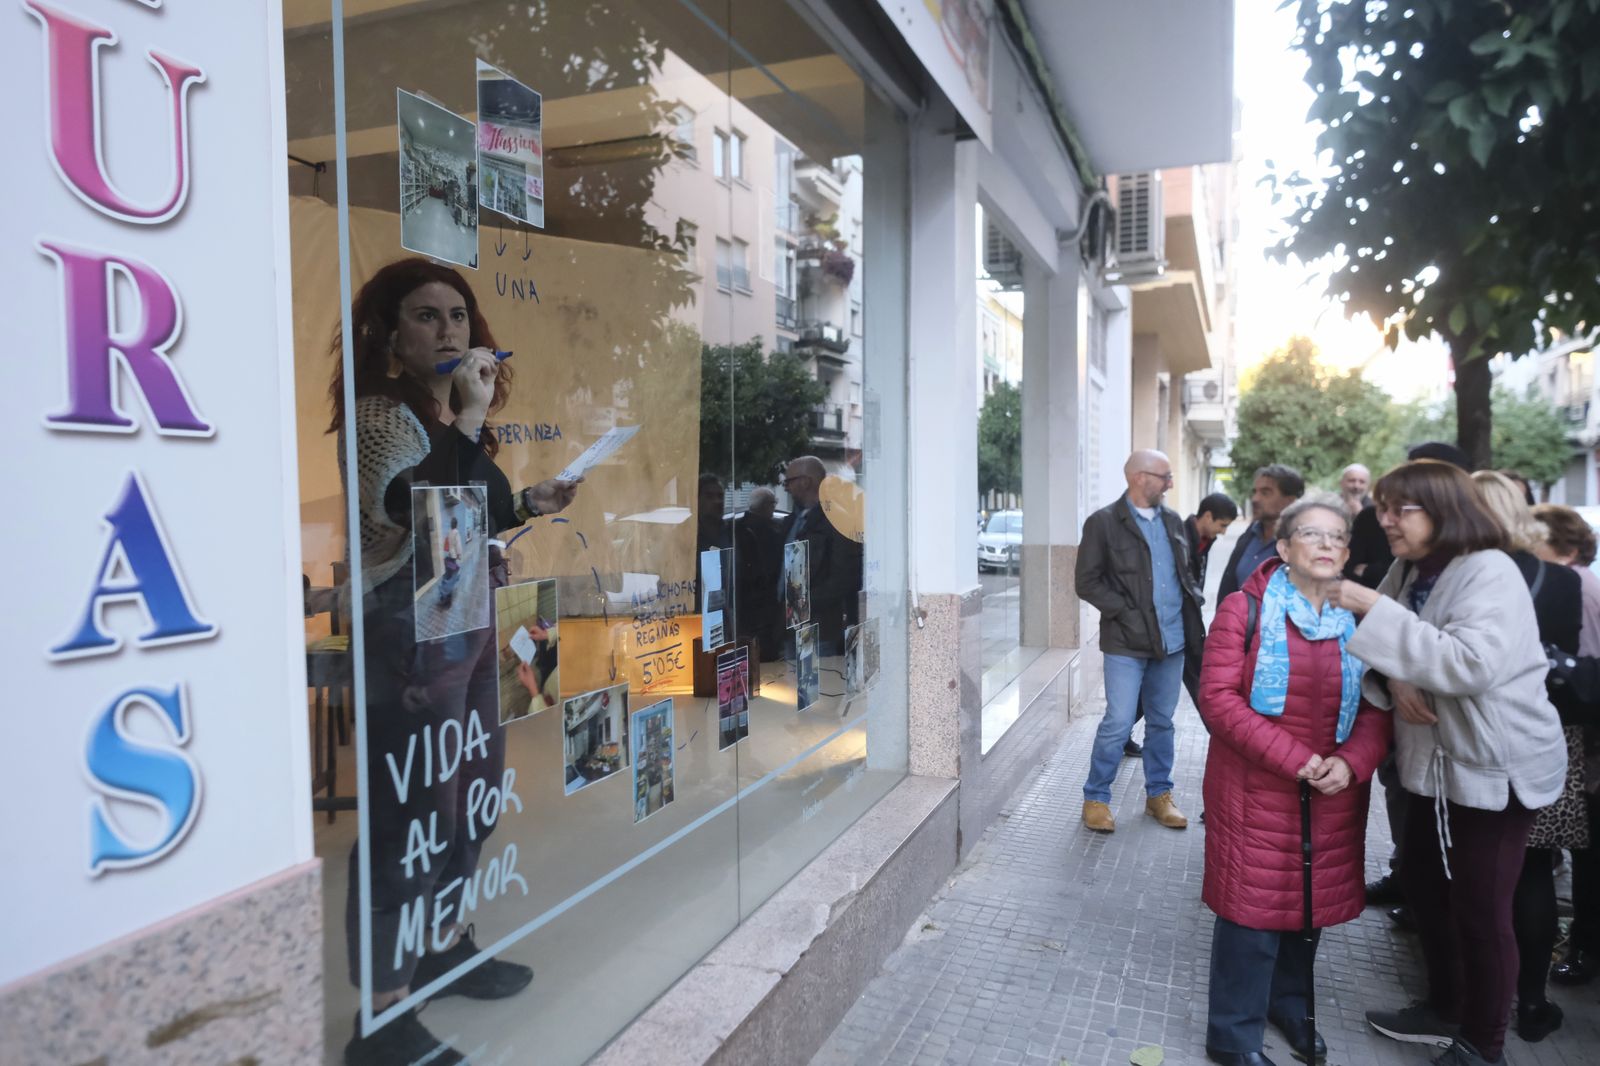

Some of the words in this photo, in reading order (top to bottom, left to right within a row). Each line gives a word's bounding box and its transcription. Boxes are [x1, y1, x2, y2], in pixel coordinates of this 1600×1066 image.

[495, 271, 541, 305] UNA
[22, 0, 219, 878] URAS
[385, 709, 491, 804] VIDA
[399, 811, 448, 879] AL
[466, 767, 523, 841] POR
[393, 843, 529, 971] MENOR
